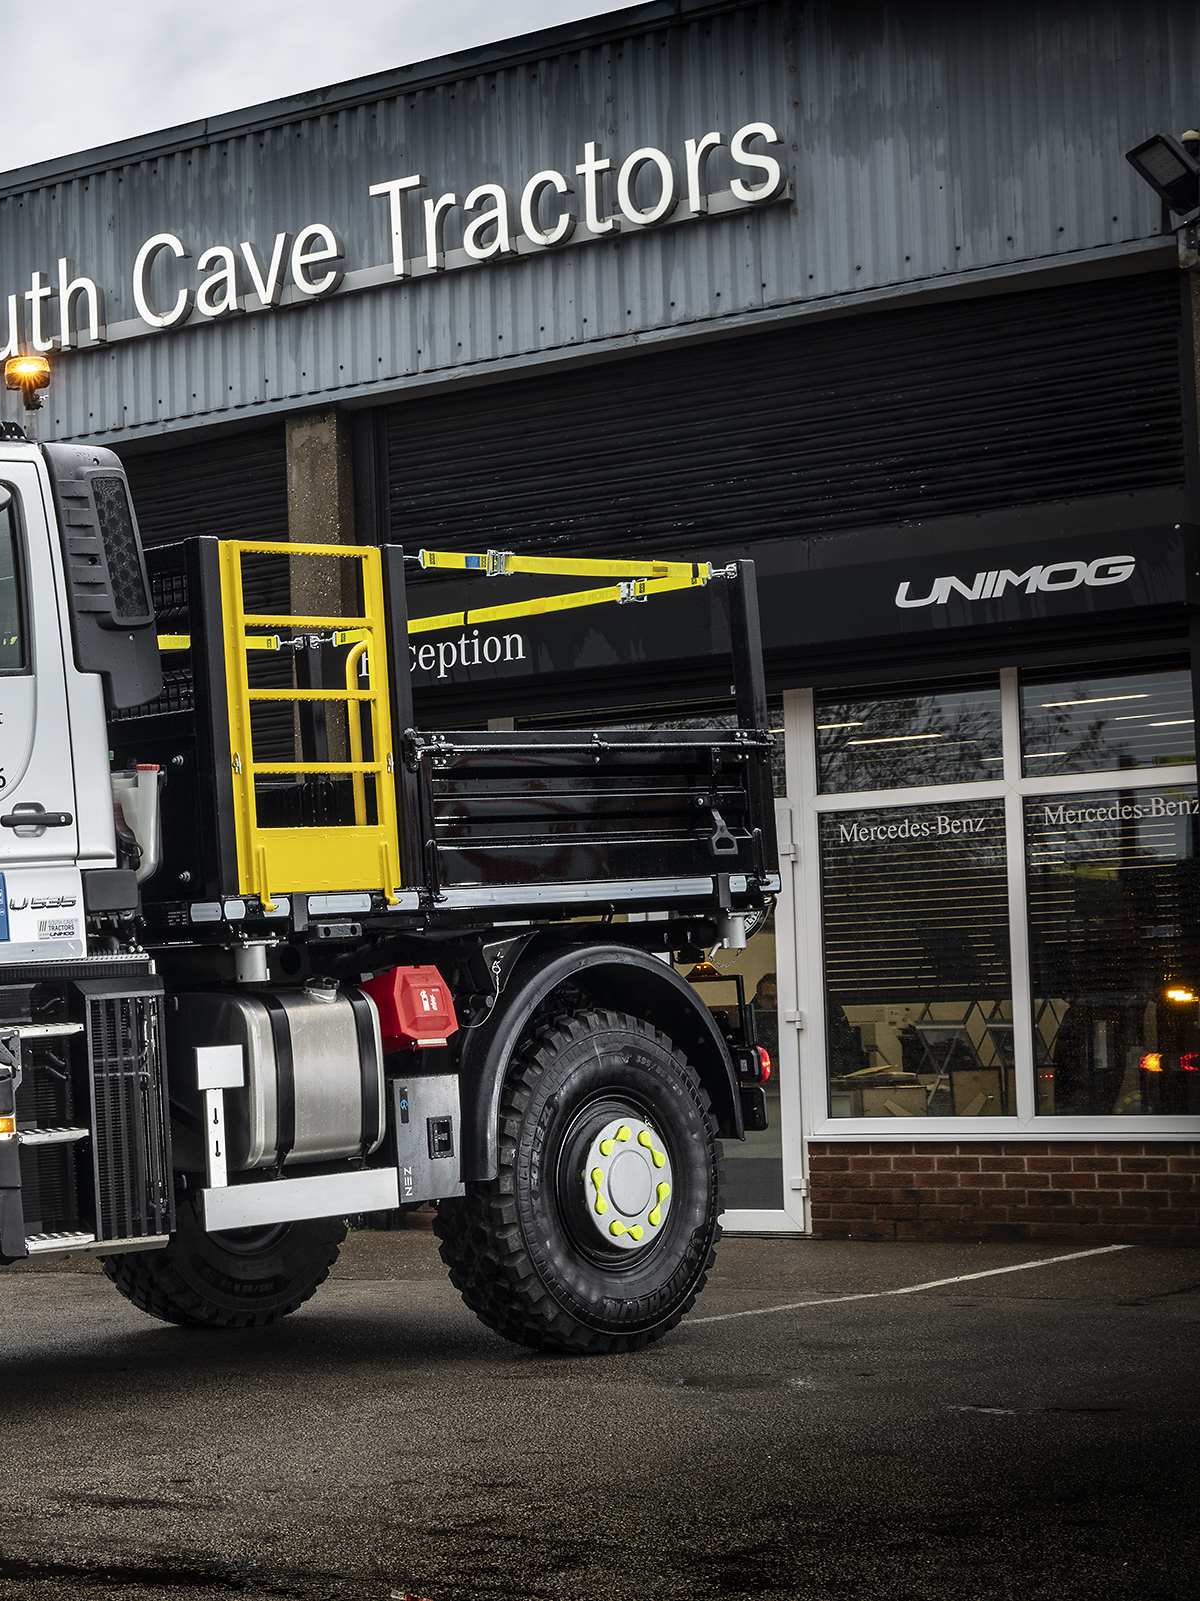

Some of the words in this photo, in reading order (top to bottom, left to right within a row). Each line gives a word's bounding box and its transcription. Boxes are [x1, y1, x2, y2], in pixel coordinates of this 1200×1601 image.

[132, 223, 341, 330] Cave
[370, 121, 785, 278] Tractors
[895, 555, 1136, 608] UNIMOG
[359, 629, 526, 679] ception
[838, 815, 986, 844] Mercedes-Benz
[1043, 796, 1200, 827] Mercedes-Benz
